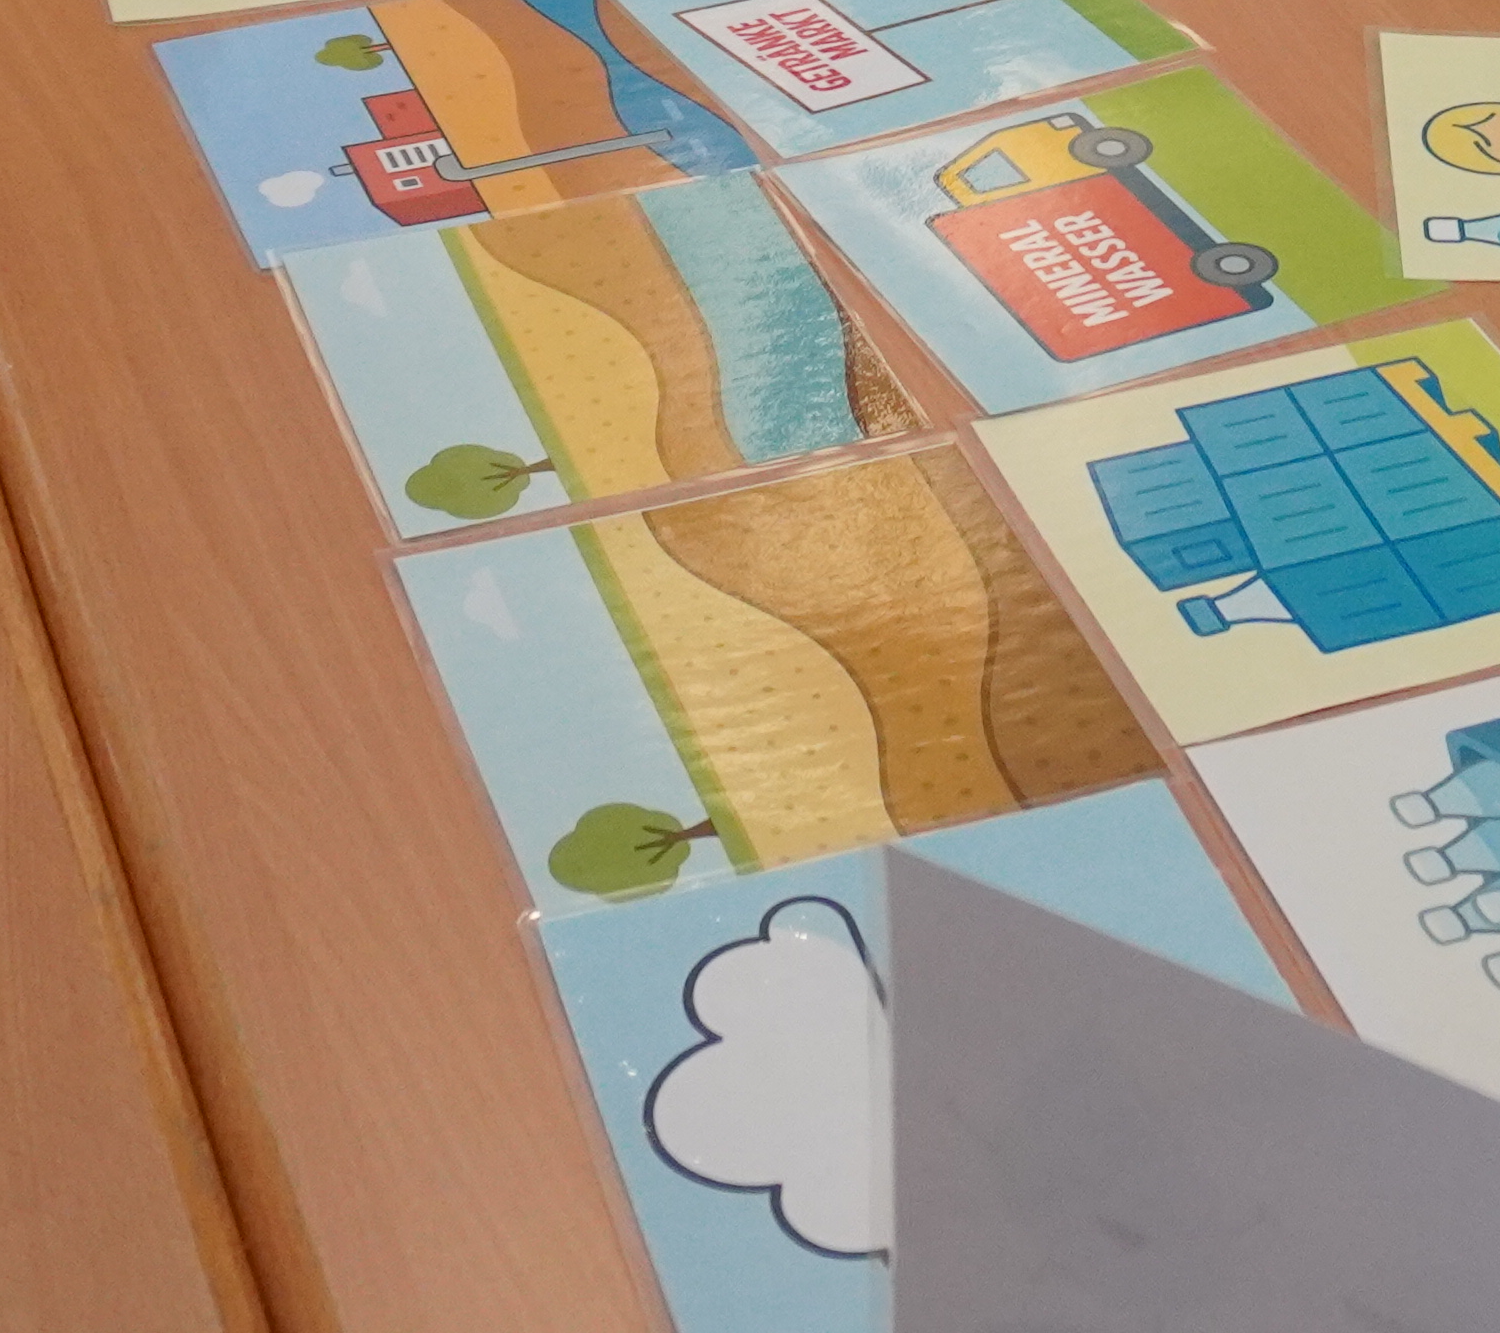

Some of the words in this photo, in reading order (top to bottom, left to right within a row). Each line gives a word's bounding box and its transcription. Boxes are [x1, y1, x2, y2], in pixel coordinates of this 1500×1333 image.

[726, 18, 850, 92] GETRÄNKE
[769, 7, 869, 60] MARKT
[999, 220, 1128, 327] MINERAL
[1055, 211, 1173, 307] WASSER
